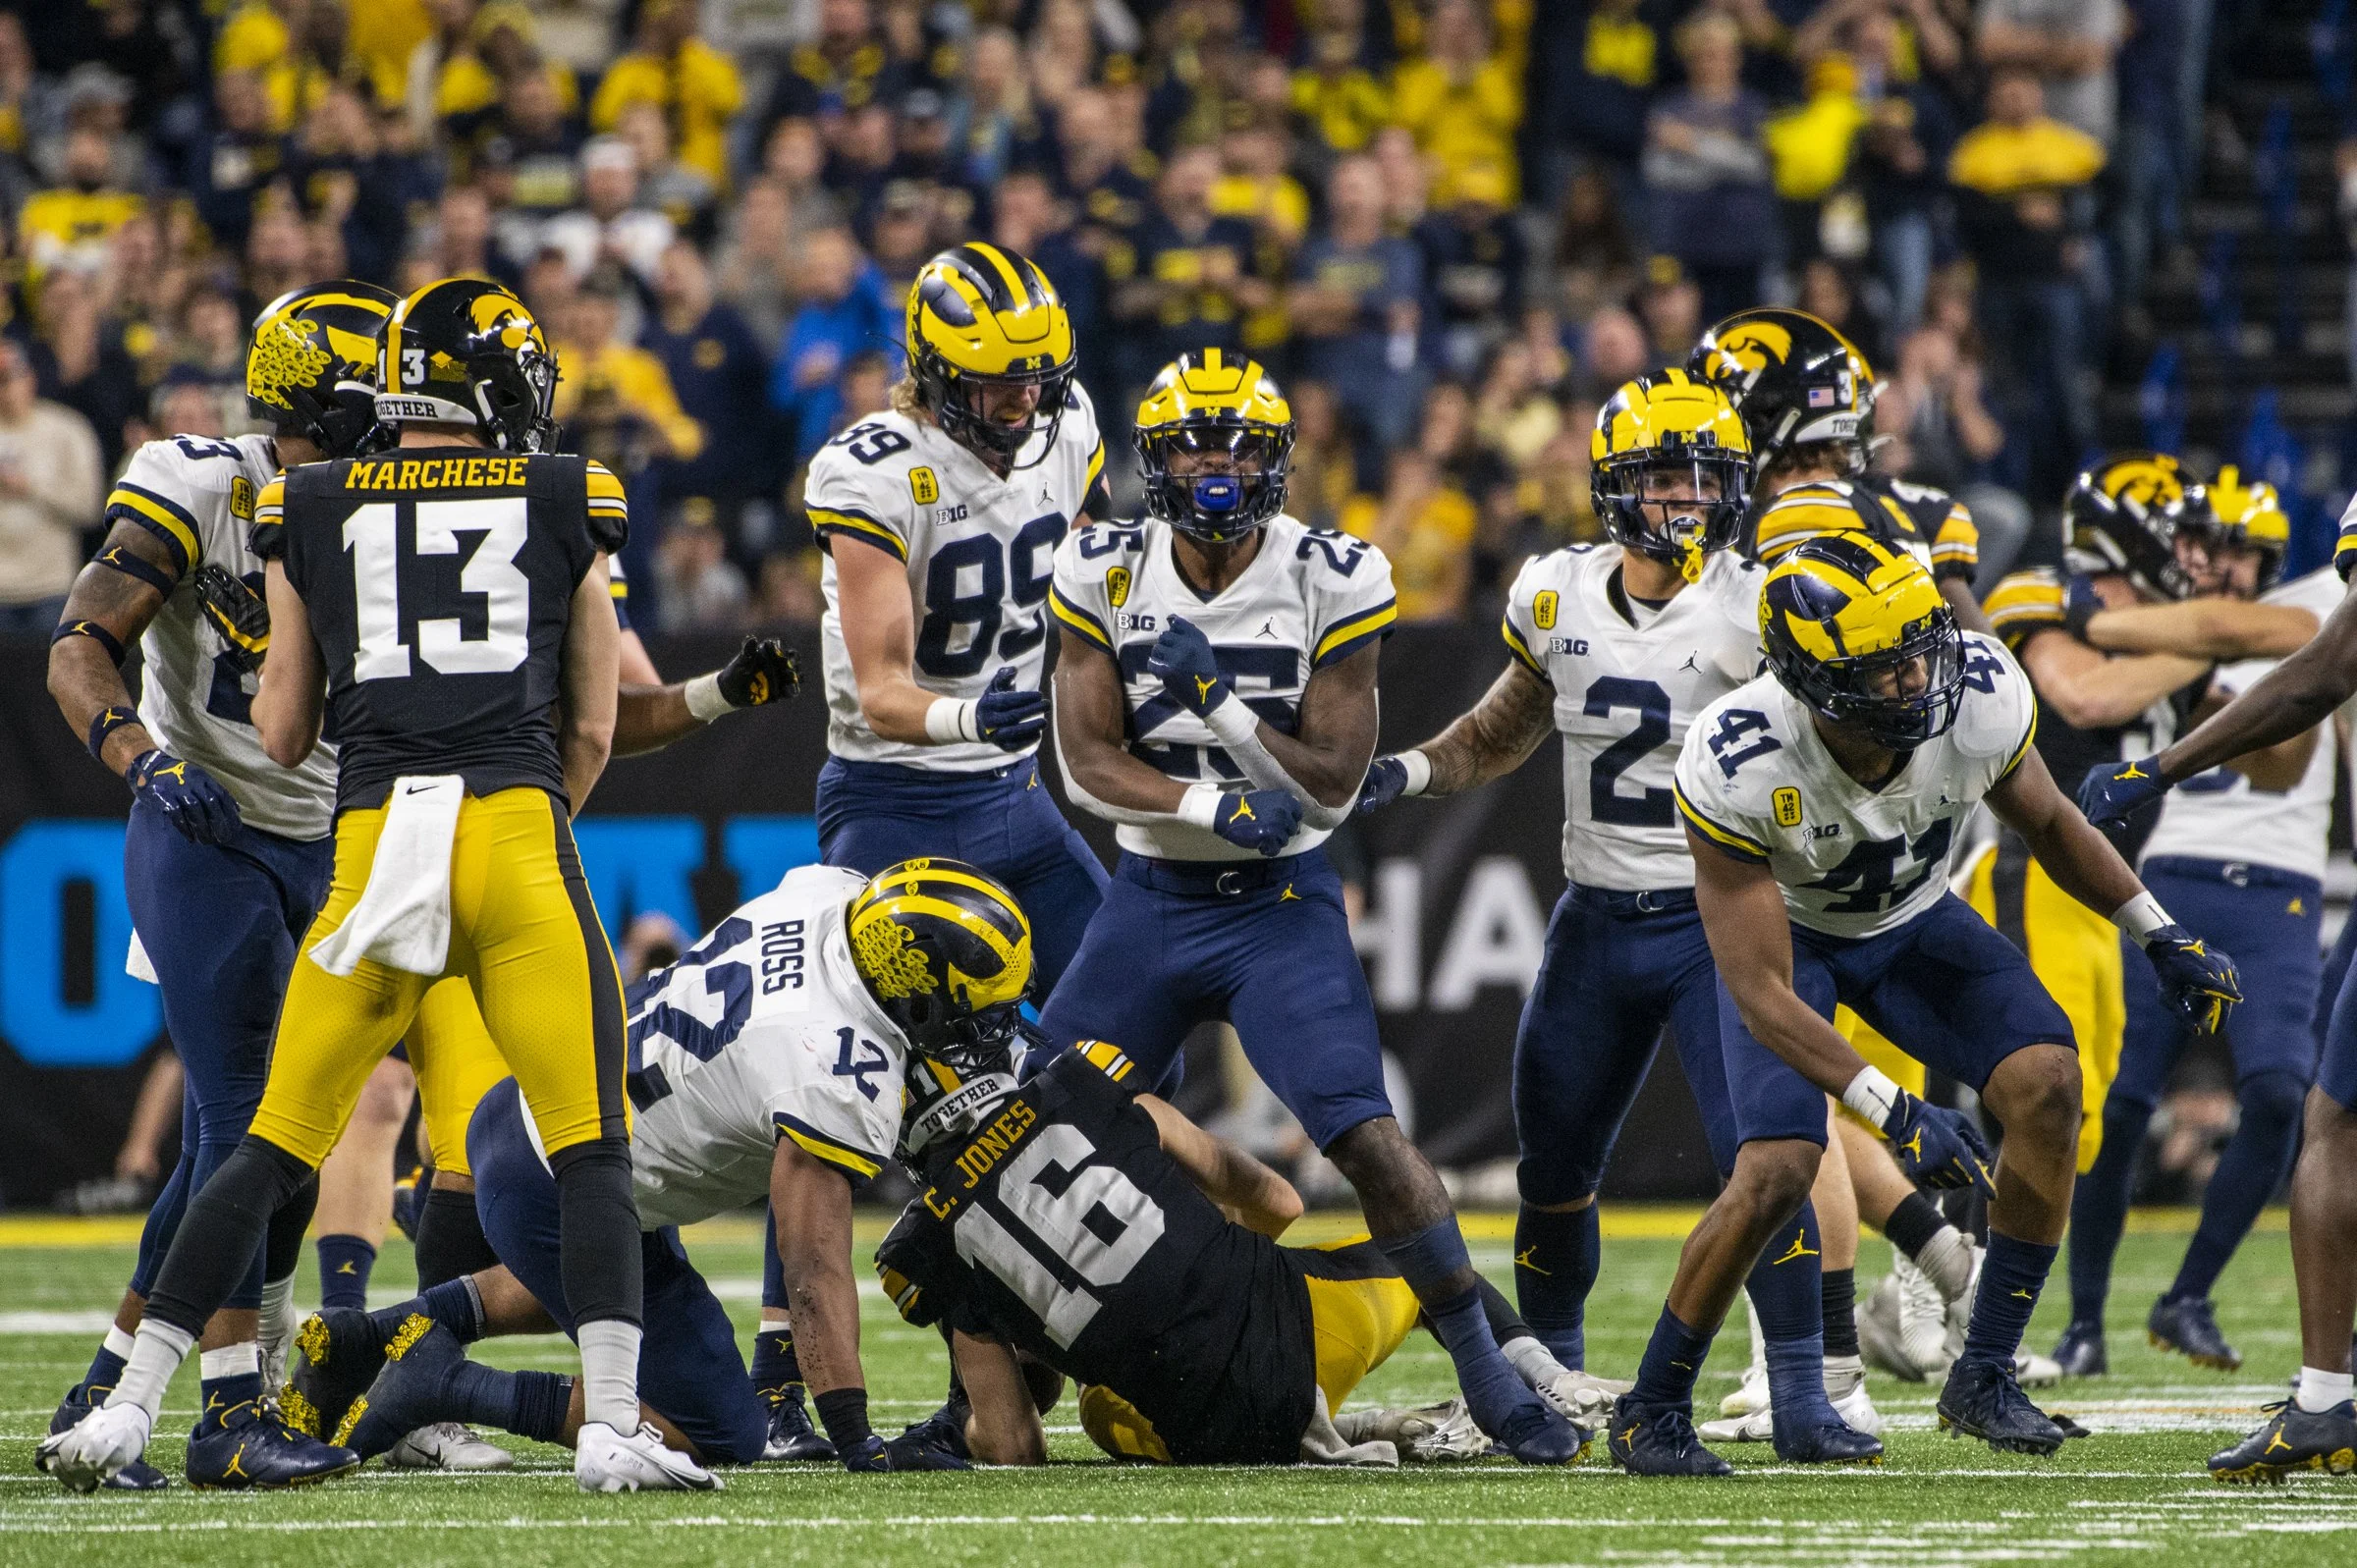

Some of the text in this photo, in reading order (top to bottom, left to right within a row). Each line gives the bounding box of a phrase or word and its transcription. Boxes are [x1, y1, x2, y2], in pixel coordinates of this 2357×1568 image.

[345, 458, 529, 489] MARCHESE
[828, 423, 911, 465] 89
[342, 497, 530, 684] 13
[914, 511, 1069, 678] 89
[1583, 675, 1675, 828] 2
[1707, 708, 1783, 781] 41
[1781, 793, 1793, 803] TM
[1782, 802, 1794, 812] 42
[1794, 816, 1952, 913] 41
[760, 919, 805, 997] ROSS
[832, 1026, 889, 1105] 12
[920, 1077, 1001, 1135] TOGETHER
[923, 1099, 1037, 1221] C. JONES
[954, 1123, 1166, 1352] 16
